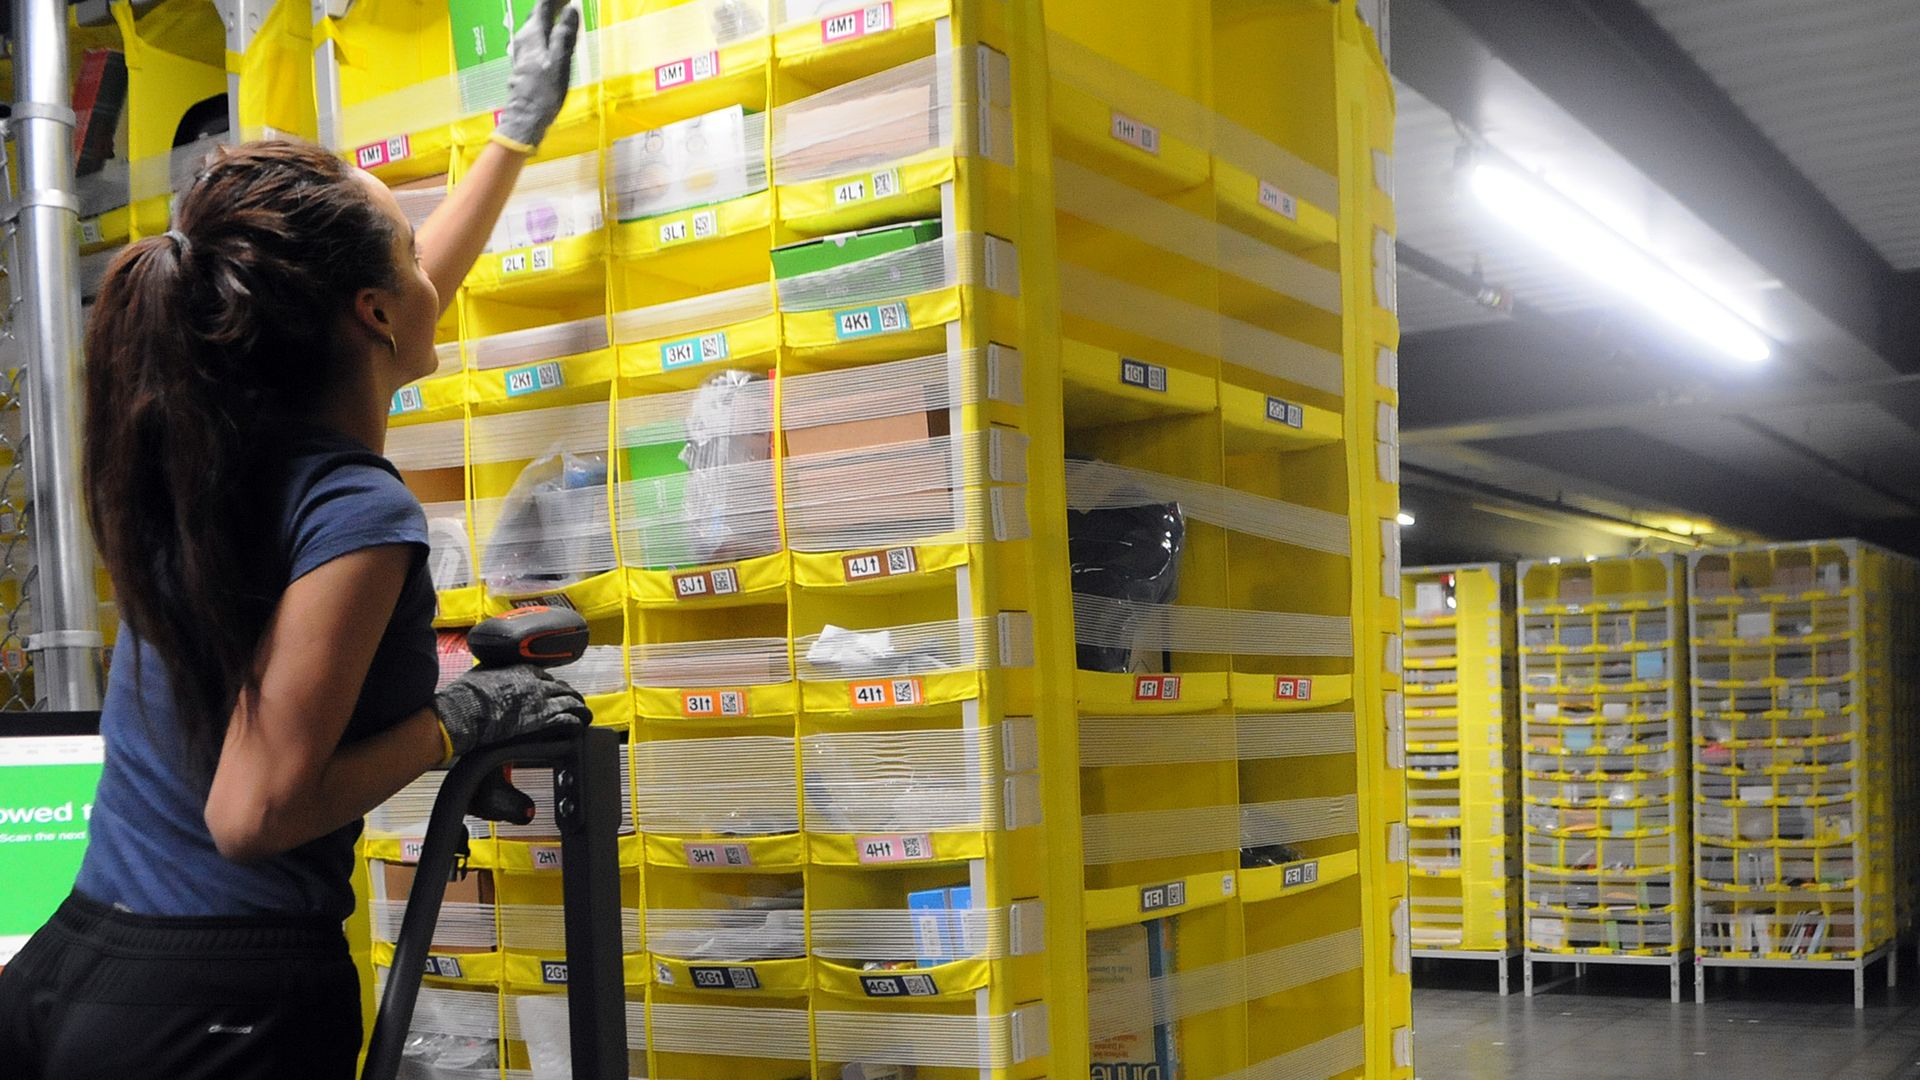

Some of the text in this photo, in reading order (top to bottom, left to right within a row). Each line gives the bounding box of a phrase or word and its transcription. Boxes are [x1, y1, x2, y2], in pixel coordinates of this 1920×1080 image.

[829, 19, 845, 34] 4M
[661, 65, 677, 81] 3M
[362, 148, 376, 162] 1M
[839, 184, 858, 200] 4L
[664, 225, 680, 241] 3L
[505, 256, 520, 271] 2L
[844, 316, 864, 331] 4K
[668, 346, 687, 362] 3K
[1126, 366, 1140, 380] 1G
[511, 375, 527, 389] 2K
[851, 560, 868, 575] 4J
[680, 578, 697, 592] 3J
[857, 687, 875, 702] 4I
[1141, 682, 1153, 696] 1F
[1280, 683, 1290, 695] 2F
[689, 698, 704, 711] 3I
[35, 833, 56, 841] the
[59, 832, 86, 840] next
[406, 844, 418, 856] 1H
[692, 848, 709, 862] 3H
[866, 842, 885, 857] 4H
[537, 851, 552, 864] 2H
[1287, 872, 1297, 885] 2E
[1146, 892, 1159, 906] 1E
[546, 967, 562, 979] 2G
[697, 969, 715, 984] 3G
[868, 978, 889, 993] 4G
